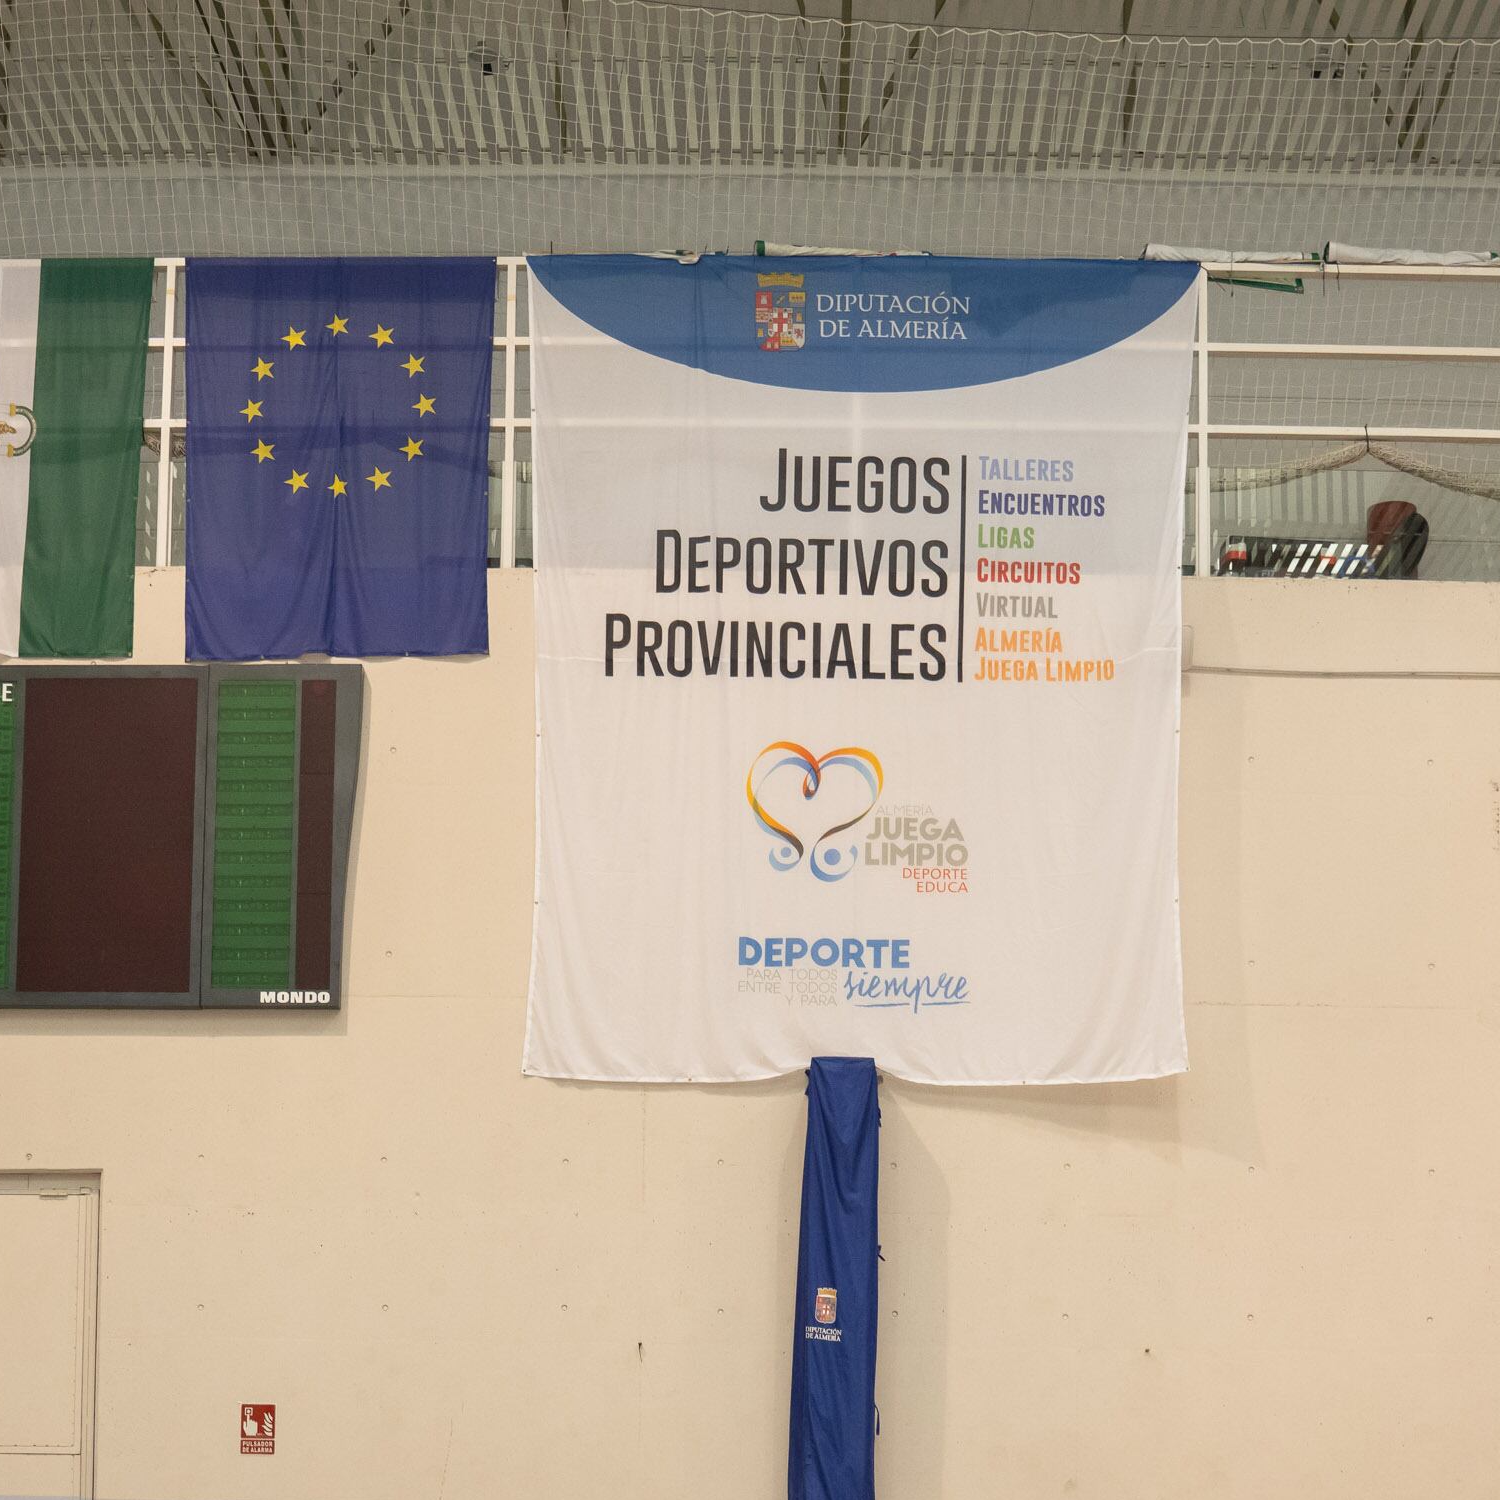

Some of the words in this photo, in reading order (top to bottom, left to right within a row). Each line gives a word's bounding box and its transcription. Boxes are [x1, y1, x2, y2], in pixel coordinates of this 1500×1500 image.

[817, 292, 969, 315] DIPUTACIÓN
[819, 319, 850, 337] DE
[858, 315, 968, 340] ALMERÍA
[760, 448, 950, 514] JUEGOS
[978, 455, 1075, 483] TALLERES
[978, 490, 1106, 518] ENCUENTROS
[977, 523, 1035, 549] LIGAS
[656, 529, 949, 598] DEPORTIVOS
[977, 558, 1081, 585] CIRCUITOS
[976, 592, 1058, 619] VIRTUAL
[605, 613, 947, 681] PROVINCIALES
[974, 625, 1063, 653] ALMERÍA
[974, 658, 1039, 682] JUEGA
[1045, 657, 1116, 681] LIMPIO
[2, 683, 13, 702] E
[866, 817, 965, 841] JUEGA
[865, 843, 968, 867] LIMPIO
[903, 868, 967, 880] DEPORTE
[917, 881, 968, 893] EDUCA
[738, 937, 910, 969] DEPORTE
[746, 968, 781, 980] PARA
[789, 969, 837, 981] TODOS
[259, 991, 331, 1004] MONDO
[738, 981, 781, 994] ENTRE
[789, 982, 837, 993] TODOS
[844, 971, 970, 1013] siempre
[800, 995, 838, 1007] PARA
[805, 1326, 842, 1335] DIPUTACIÓN
